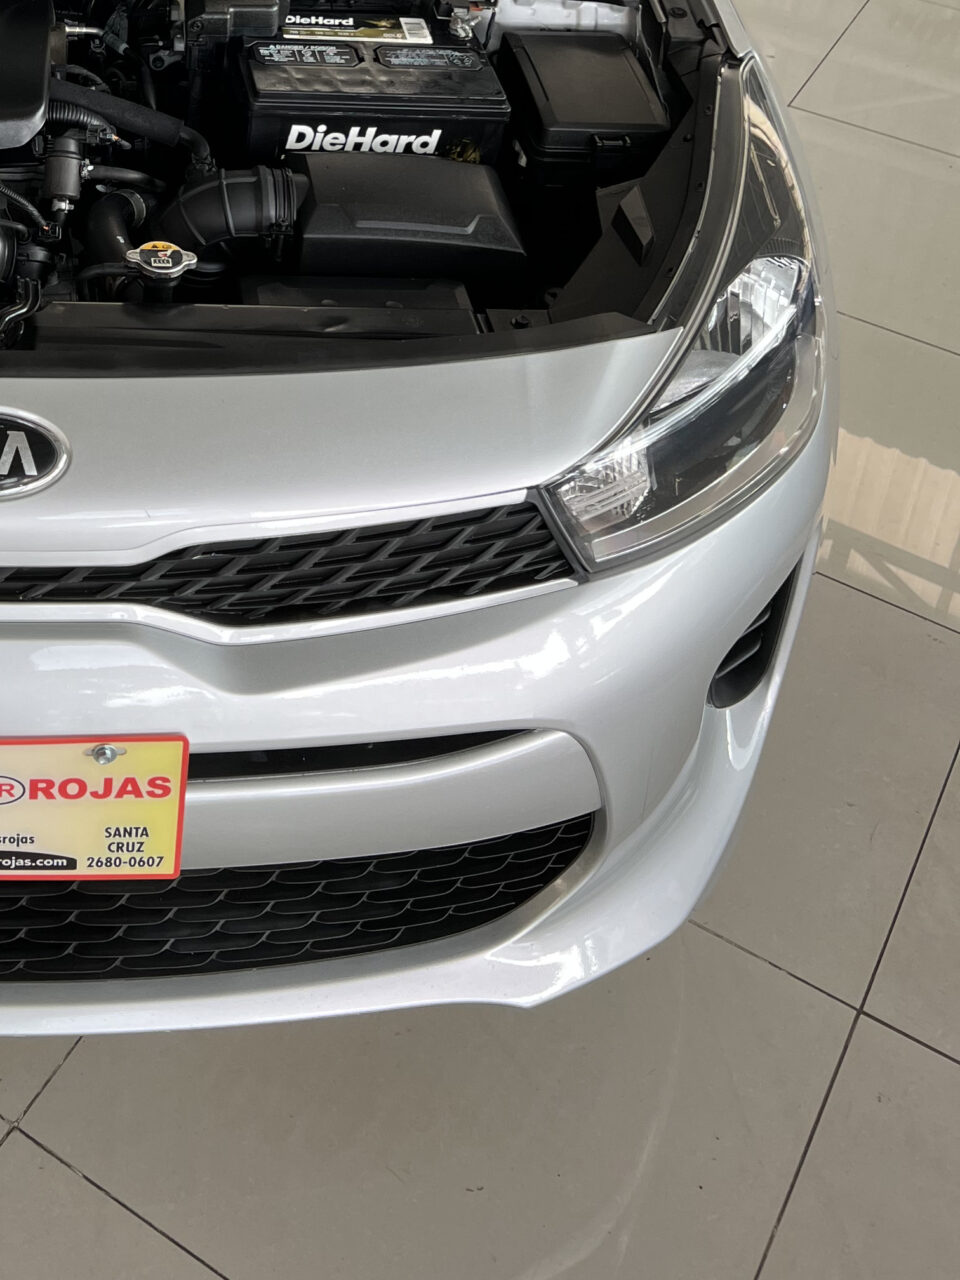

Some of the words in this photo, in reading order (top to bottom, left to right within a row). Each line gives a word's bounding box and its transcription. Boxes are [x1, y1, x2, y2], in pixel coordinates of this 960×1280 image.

[285, 15, 354, 26] DieHard
[285, 124, 443, 155] DieHard
[28, 776, 172, 800] ROJAS
[104, 826, 149, 838] SANTA
[107, 841, 145, 853] CRUZ
[86, 856, 164, 868] 2680-0607
